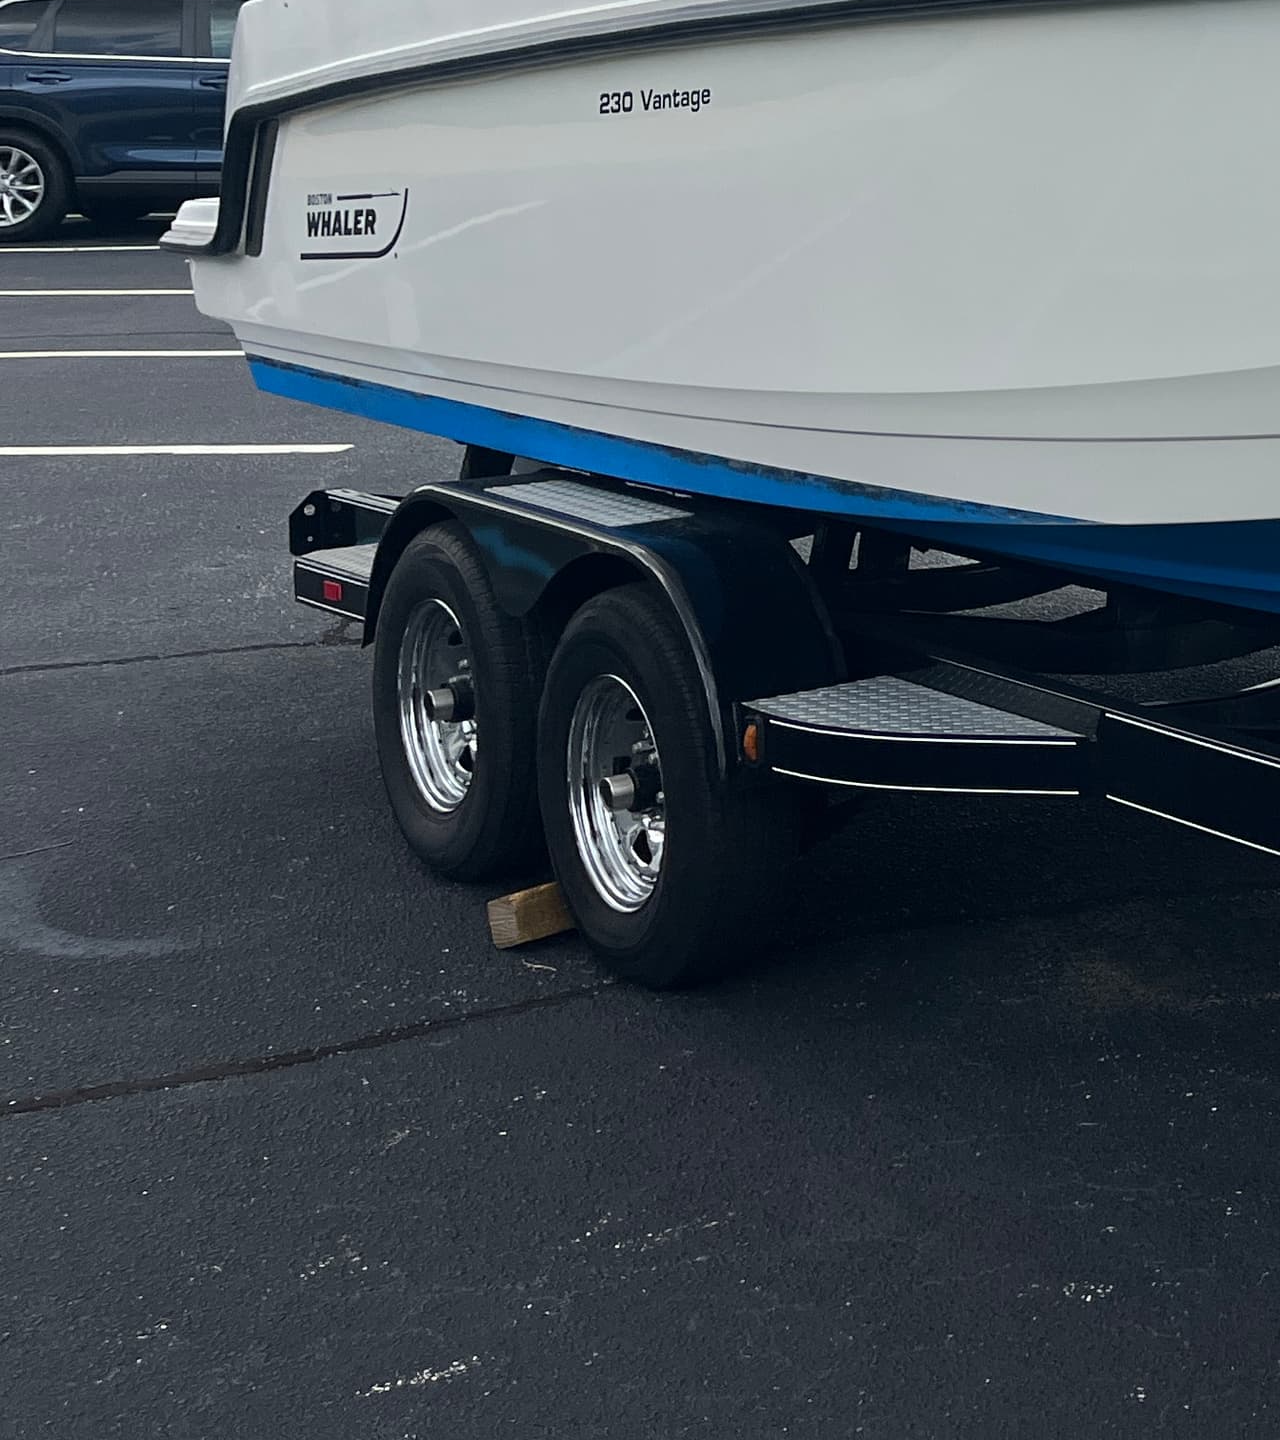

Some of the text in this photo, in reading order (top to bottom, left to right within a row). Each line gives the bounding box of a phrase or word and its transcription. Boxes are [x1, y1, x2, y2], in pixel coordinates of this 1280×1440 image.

[599, 88, 711, 114] 230 Vantage
[307, 193, 332, 206] BOSTON
[307, 208, 377, 238] WHALER
